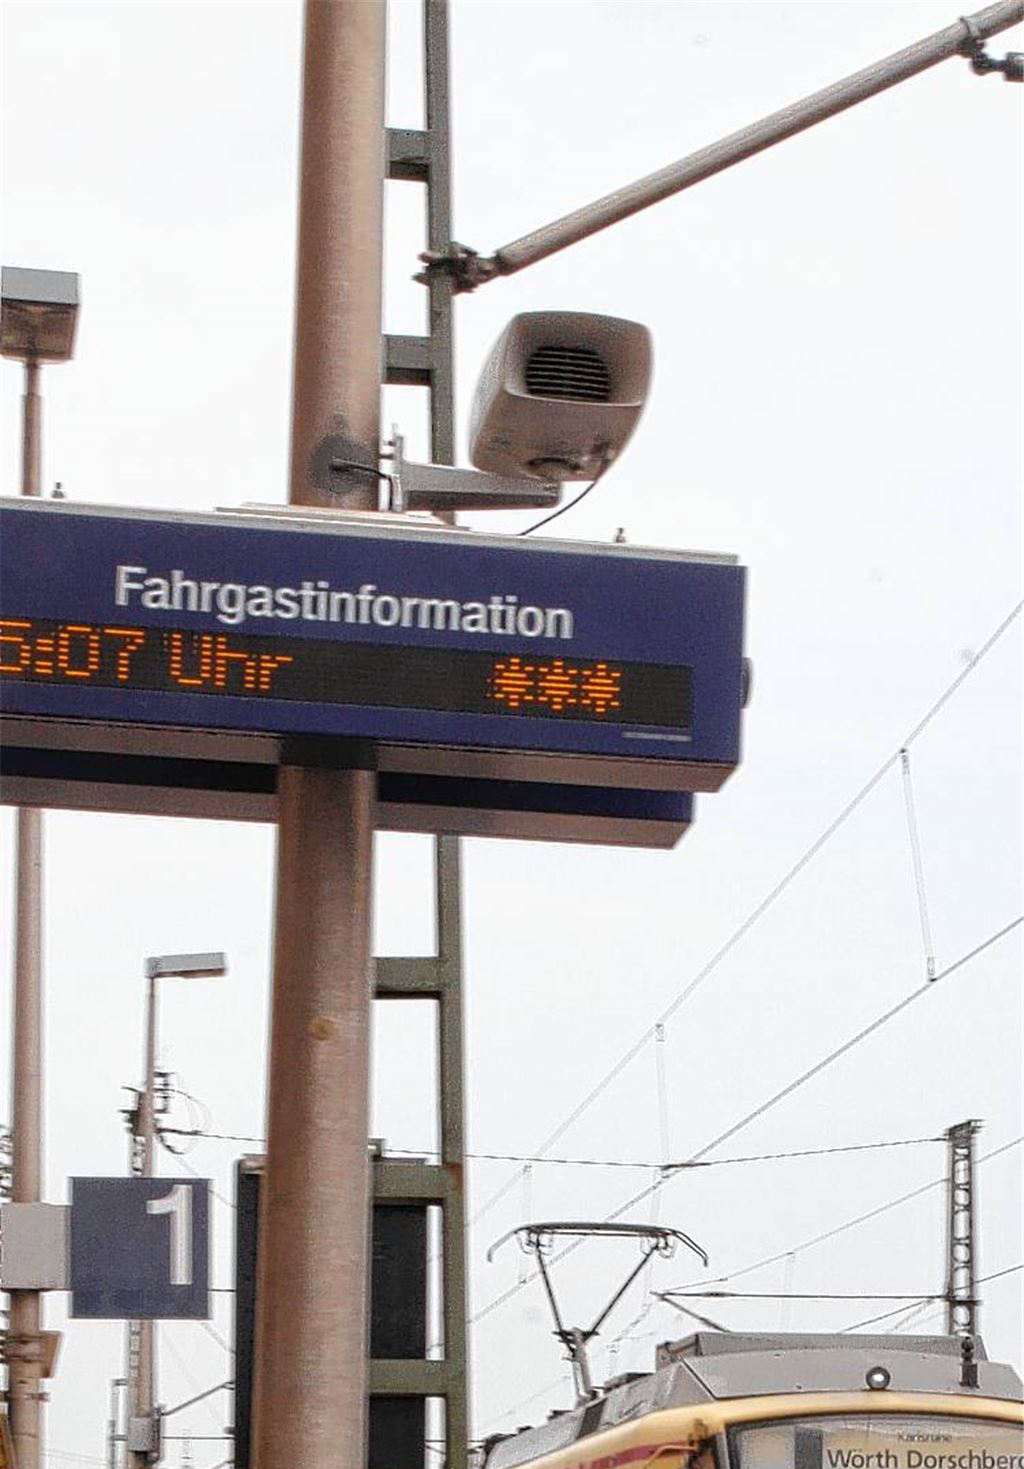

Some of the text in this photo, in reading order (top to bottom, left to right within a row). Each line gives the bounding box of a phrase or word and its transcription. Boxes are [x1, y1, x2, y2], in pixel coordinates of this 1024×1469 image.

[114, 564, 574, 639] Fahrgastinformation
[169, 631, 294, 690] Uhr
[145, 1183, 193, 1286] 1
[826, 1448, 898, 1469] Wörth
